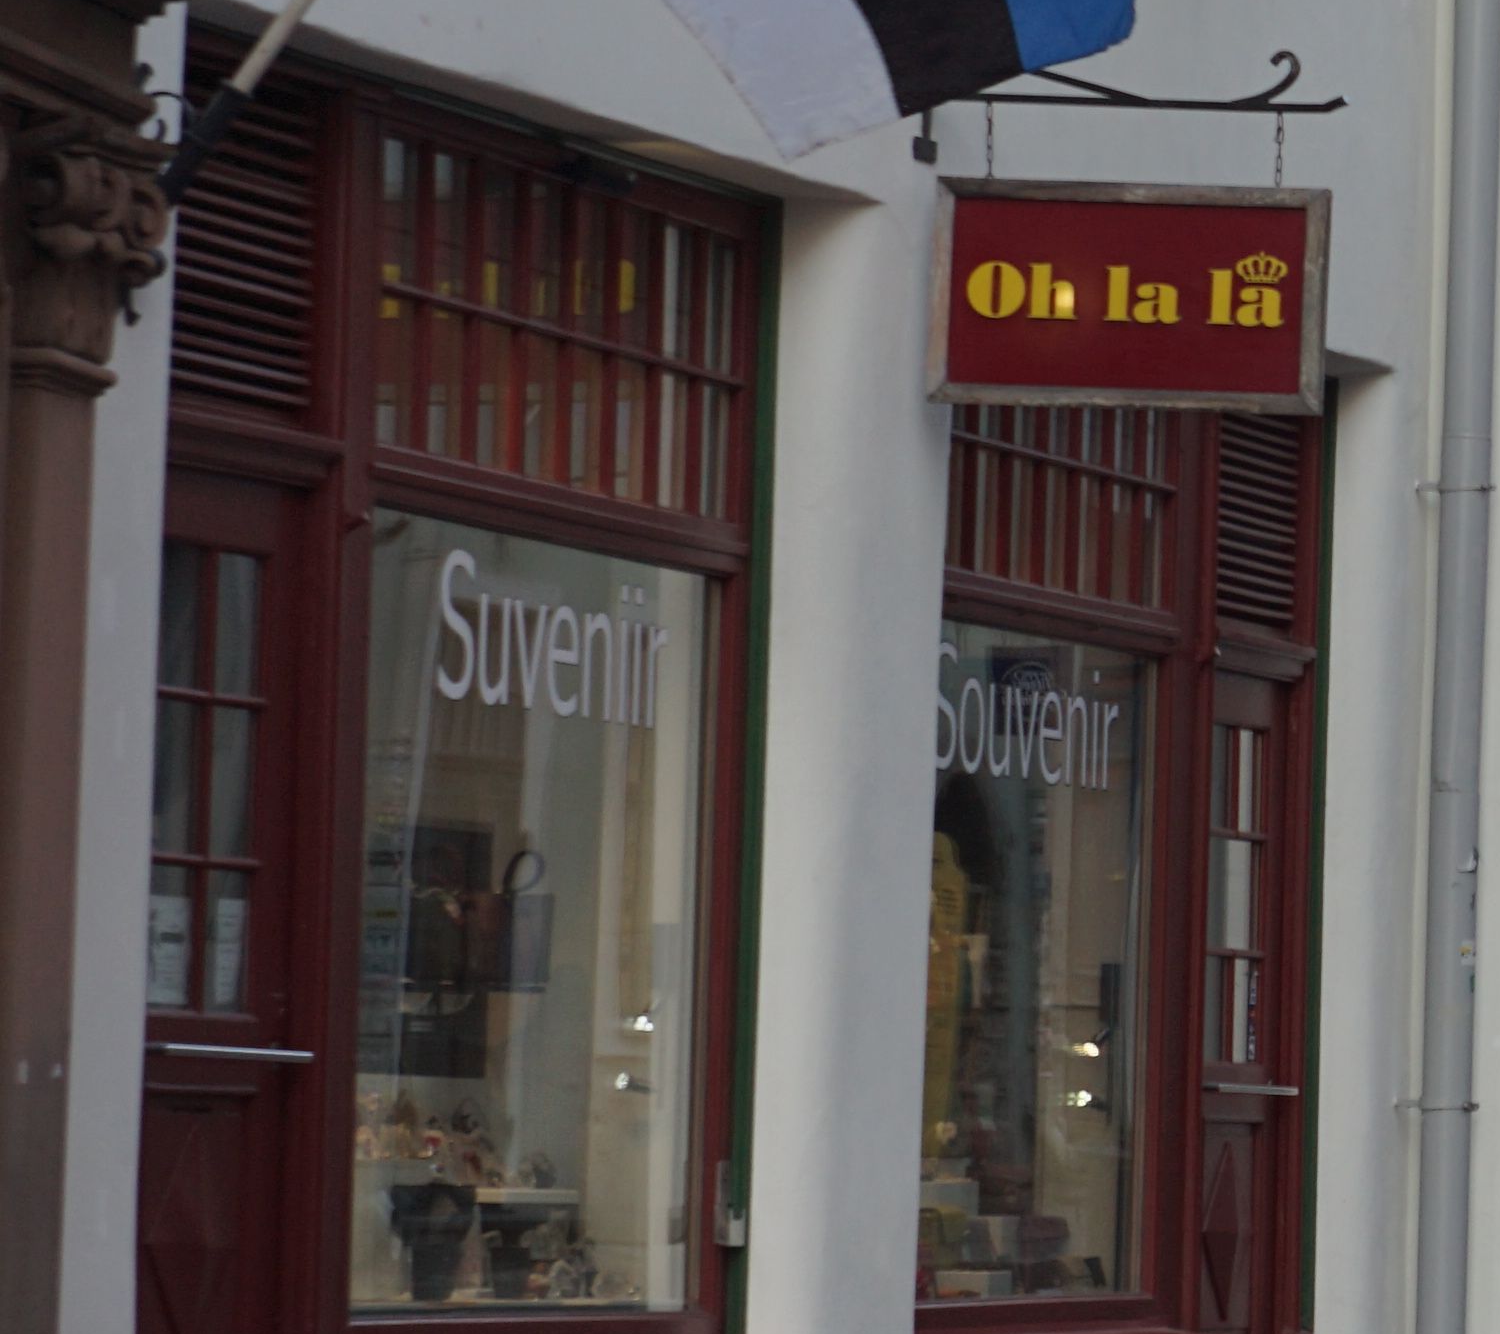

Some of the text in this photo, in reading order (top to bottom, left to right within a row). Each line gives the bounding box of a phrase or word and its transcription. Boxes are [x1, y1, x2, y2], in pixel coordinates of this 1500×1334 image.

[966, 260, 1078, 323] Oh
[1104, 265, 1182, 326] la
[436, 549, 668, 729] Suveniir
[936, 642, 1120, 789] Souvenir
